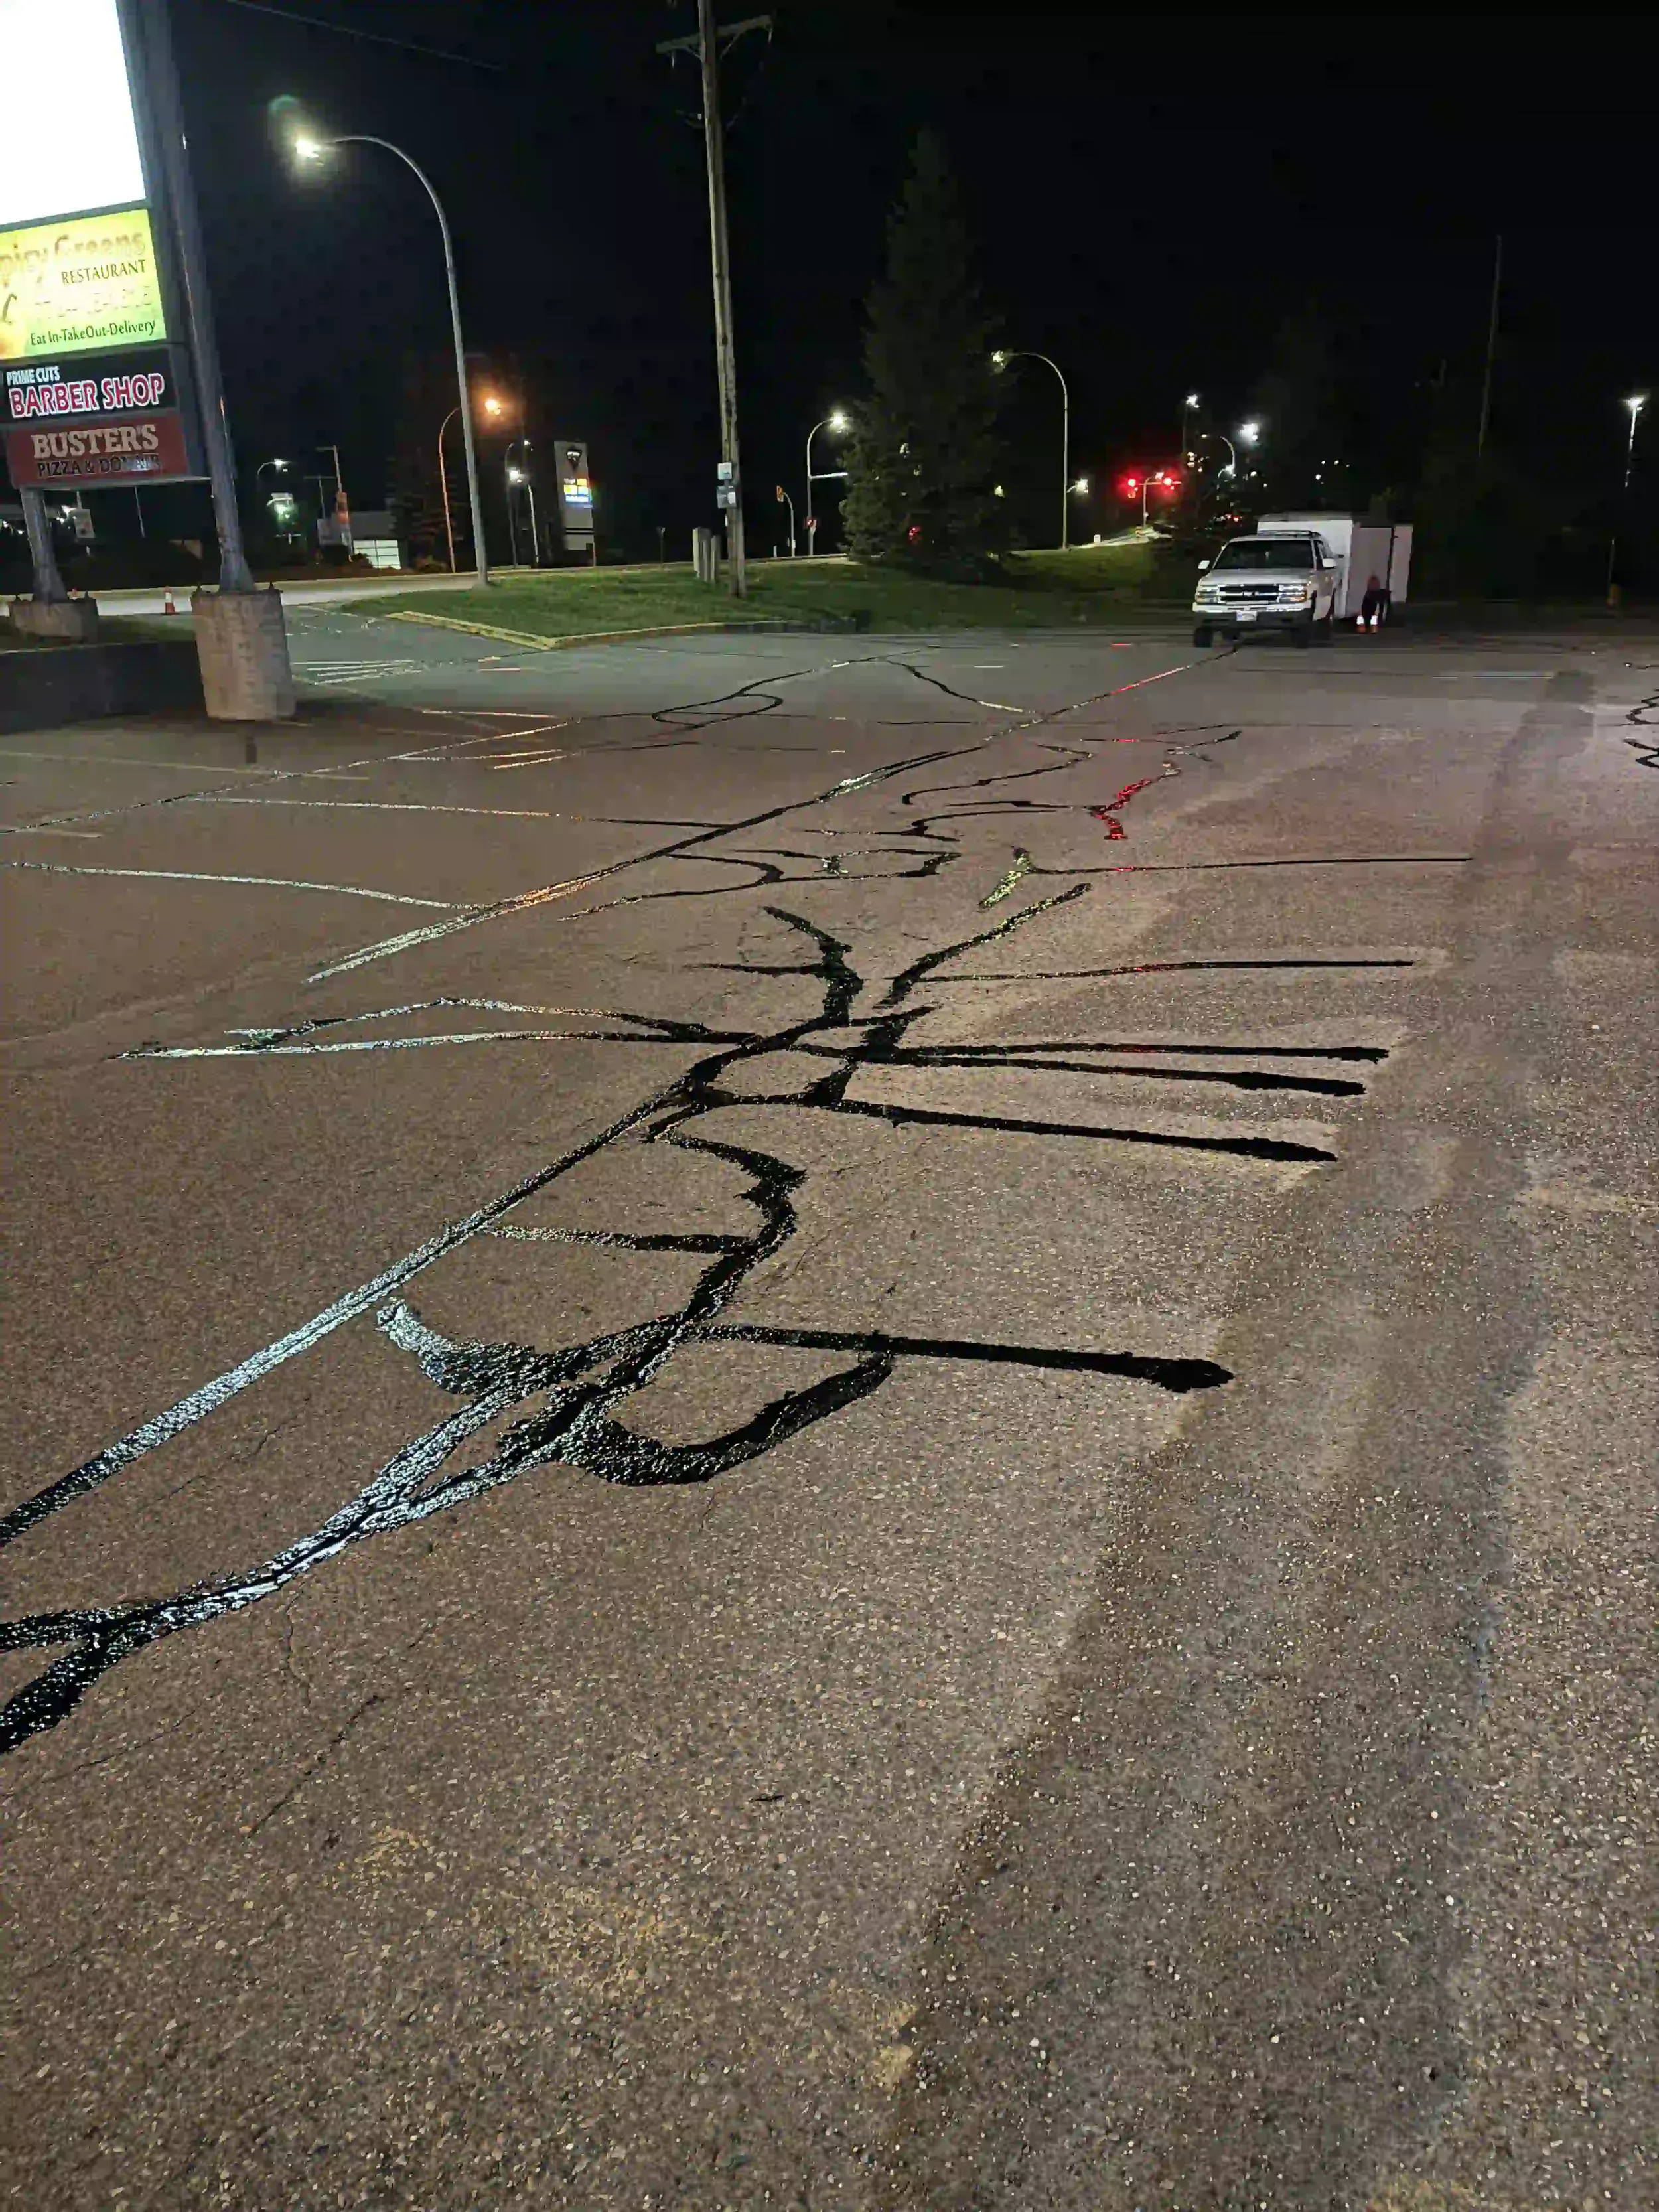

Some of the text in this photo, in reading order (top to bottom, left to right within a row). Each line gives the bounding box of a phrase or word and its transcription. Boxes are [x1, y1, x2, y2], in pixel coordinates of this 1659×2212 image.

[61, 259, 145, 285] RESTAURANT
[31, 332, 46, 345] Eat
[6, 366, 60, 386] PRIME CUTS
[8, 372, 165, 418] BARBER SHOP
[38, 459, 82, 478] PIZZA
